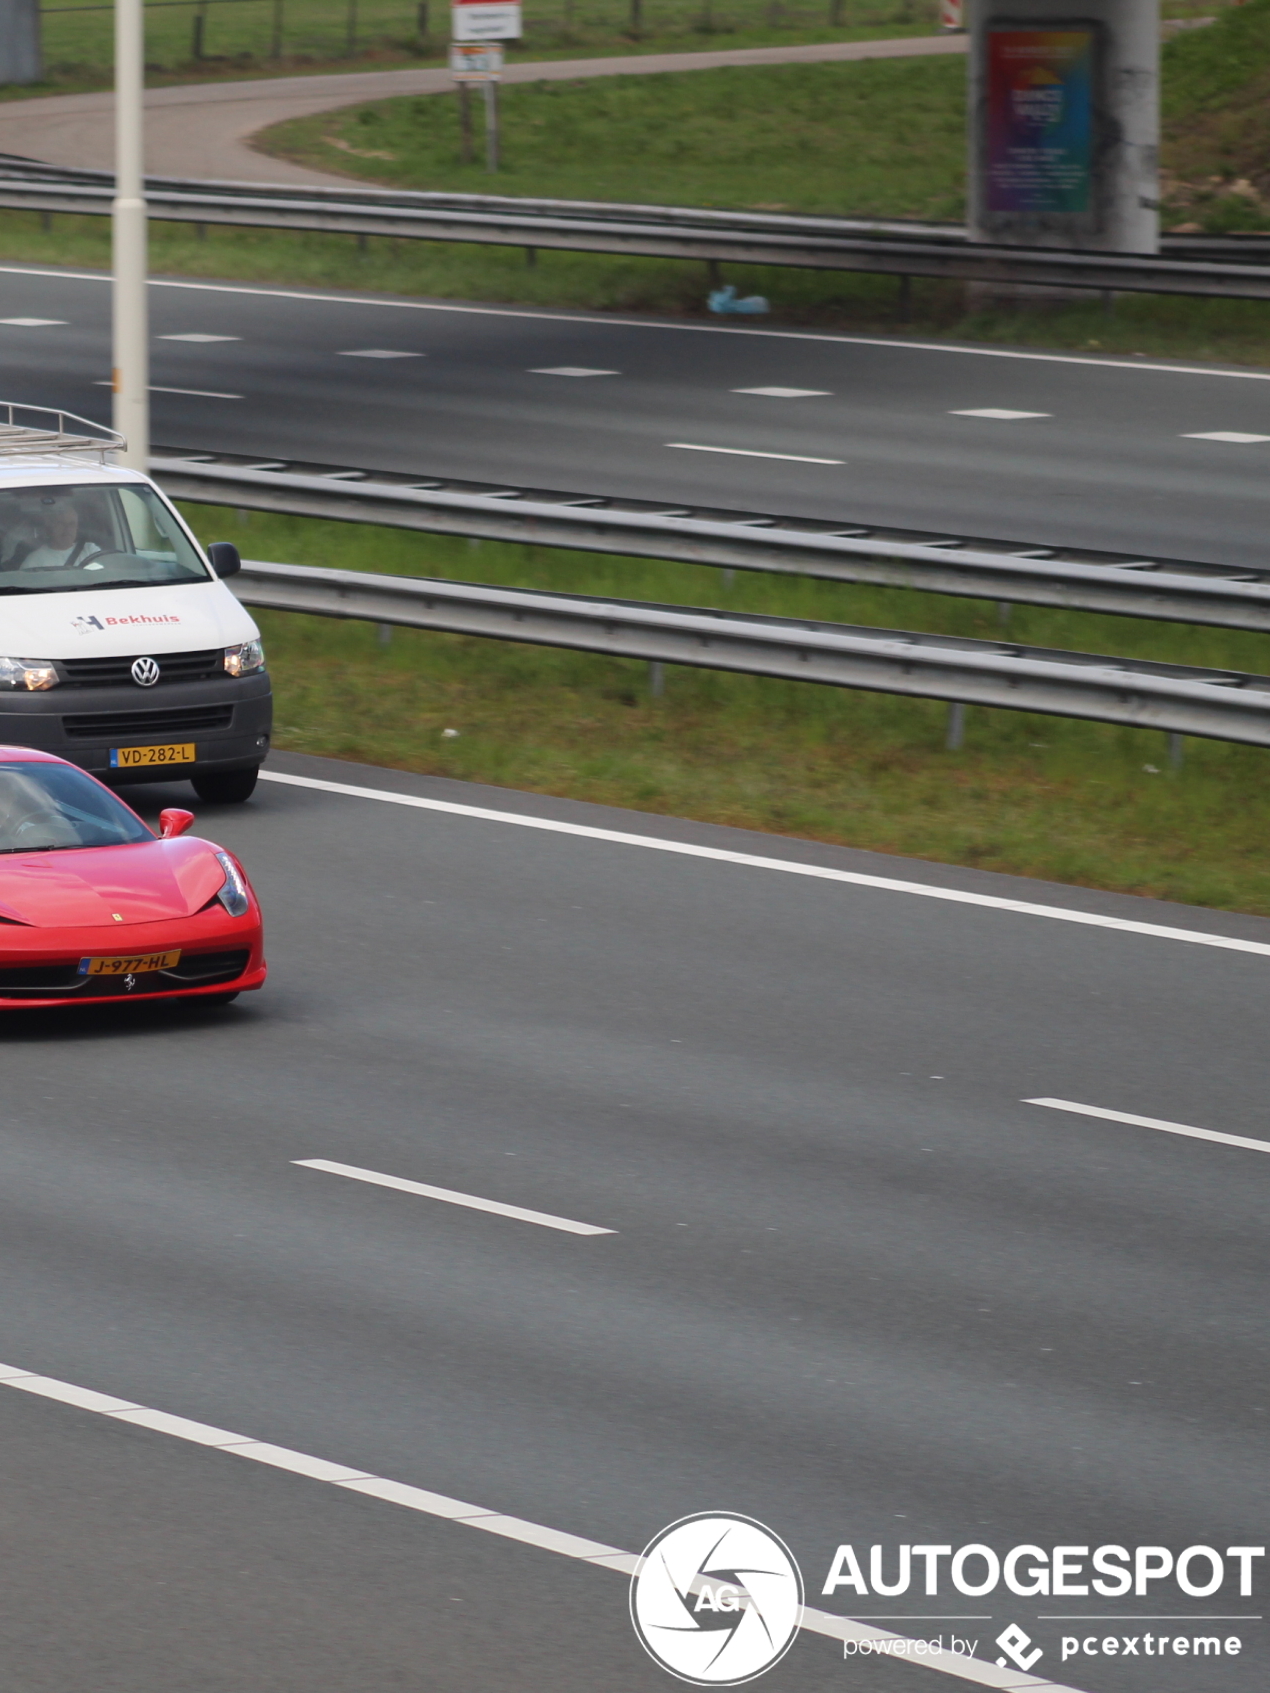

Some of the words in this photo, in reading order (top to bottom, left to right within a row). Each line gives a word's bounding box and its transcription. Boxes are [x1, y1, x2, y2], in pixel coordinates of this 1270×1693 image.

[105, 614, 180, 626] Bekhuis
[122, 746, 190, 764] VD-282-L
[94, 955, 169, 974] J-977-HL
